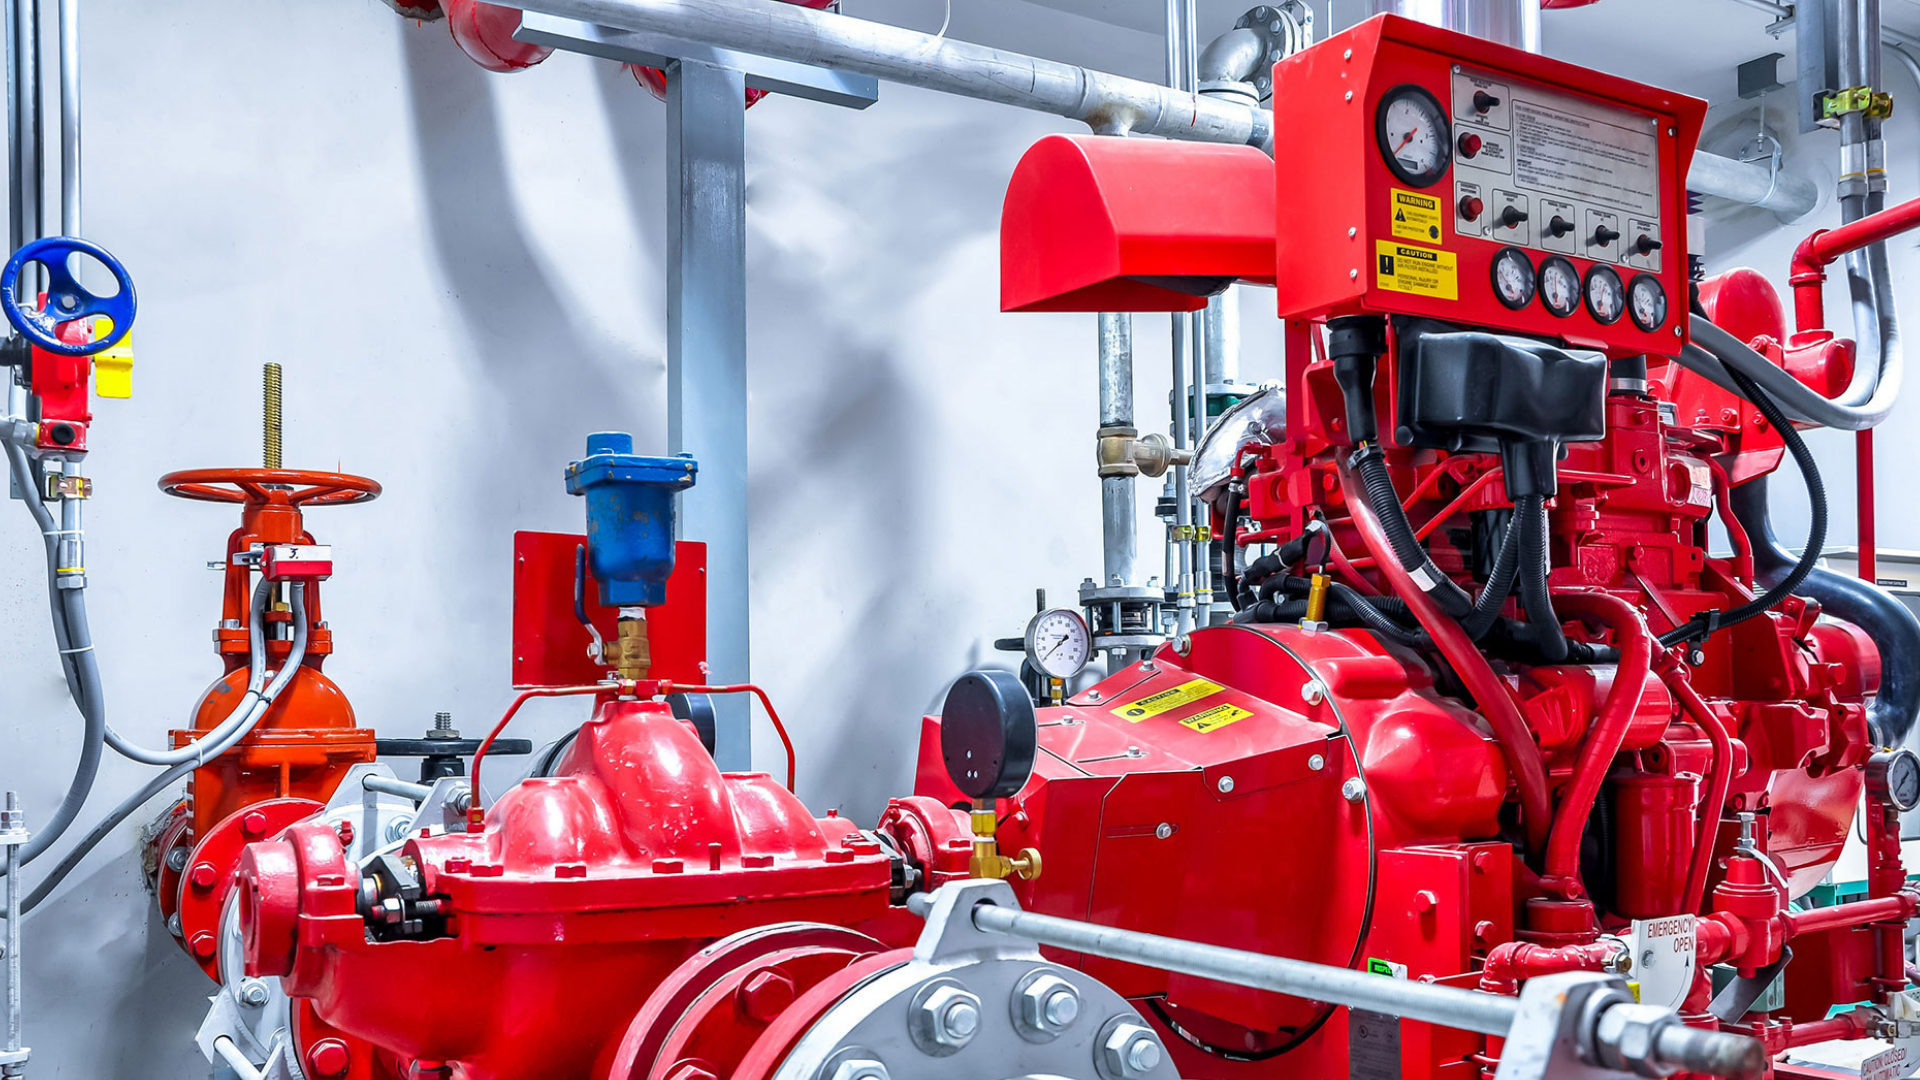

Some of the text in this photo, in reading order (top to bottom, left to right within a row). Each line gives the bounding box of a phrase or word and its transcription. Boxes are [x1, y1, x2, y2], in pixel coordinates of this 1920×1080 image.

[1398, 194, 1434, 209] WARNING
[1400, 248, 1433, 259] CAUTION
[1674, 936, 1694, 952] OPEN
